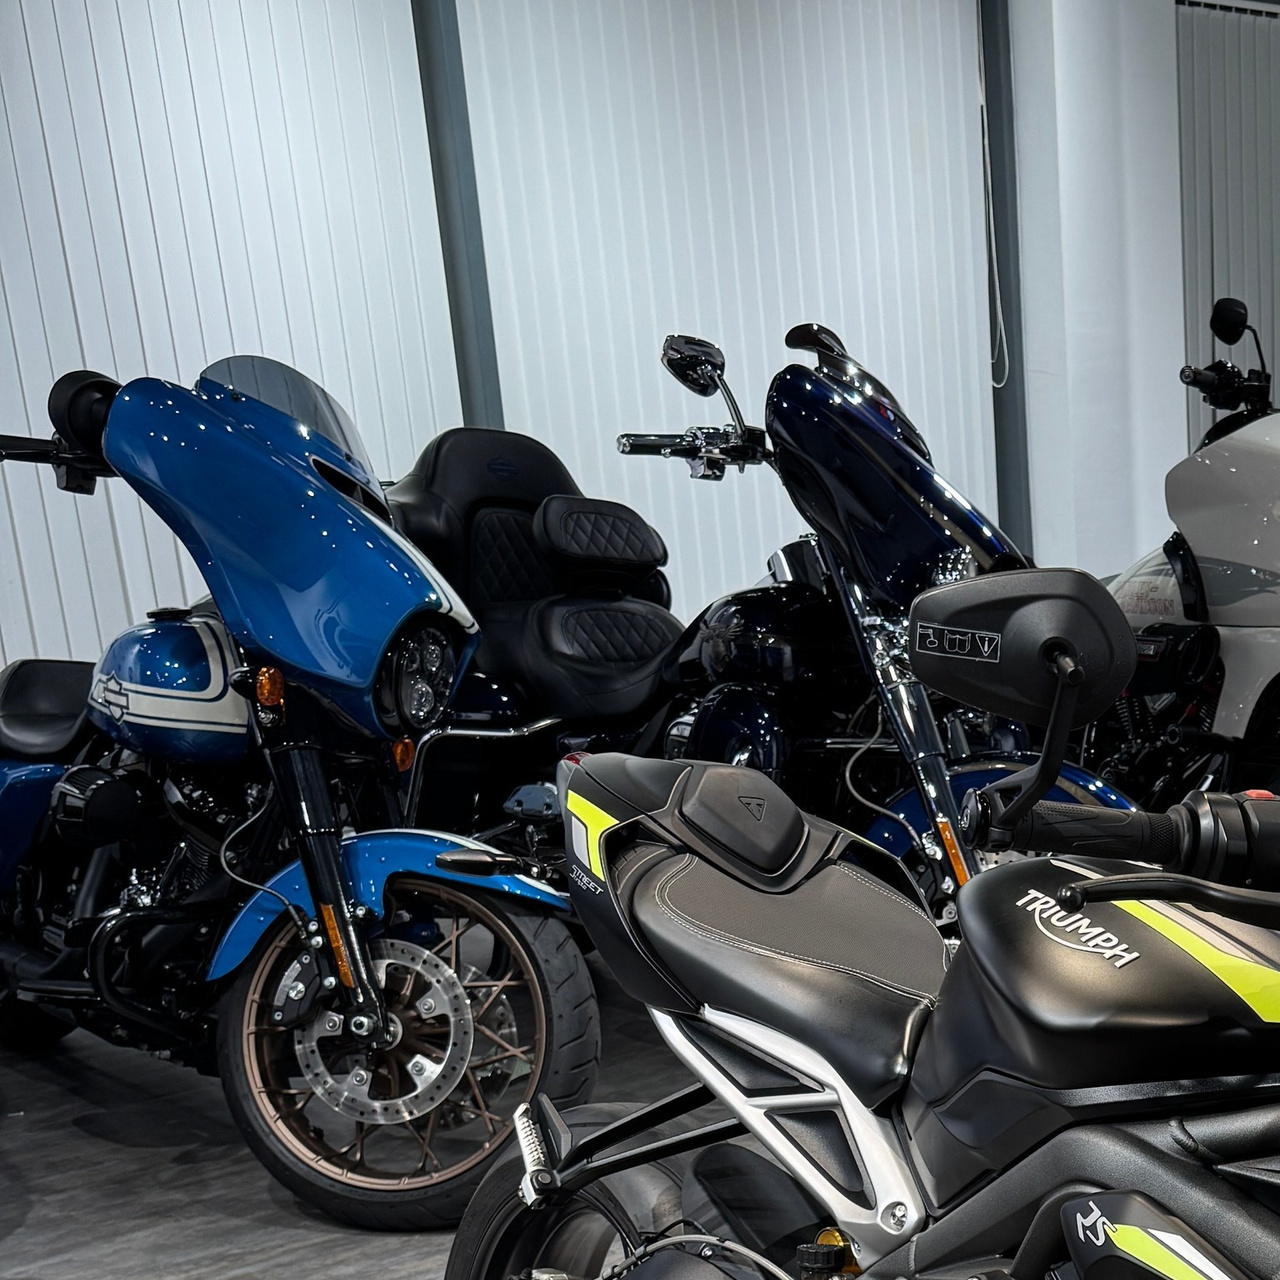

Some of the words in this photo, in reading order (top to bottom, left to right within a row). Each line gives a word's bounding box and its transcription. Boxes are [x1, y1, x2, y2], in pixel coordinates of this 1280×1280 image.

[569, 864, 604, 895] STREET
[1015, 888, 1141, 969] TRIUMPH
[1076, 1200, 1118, 1247] RS
